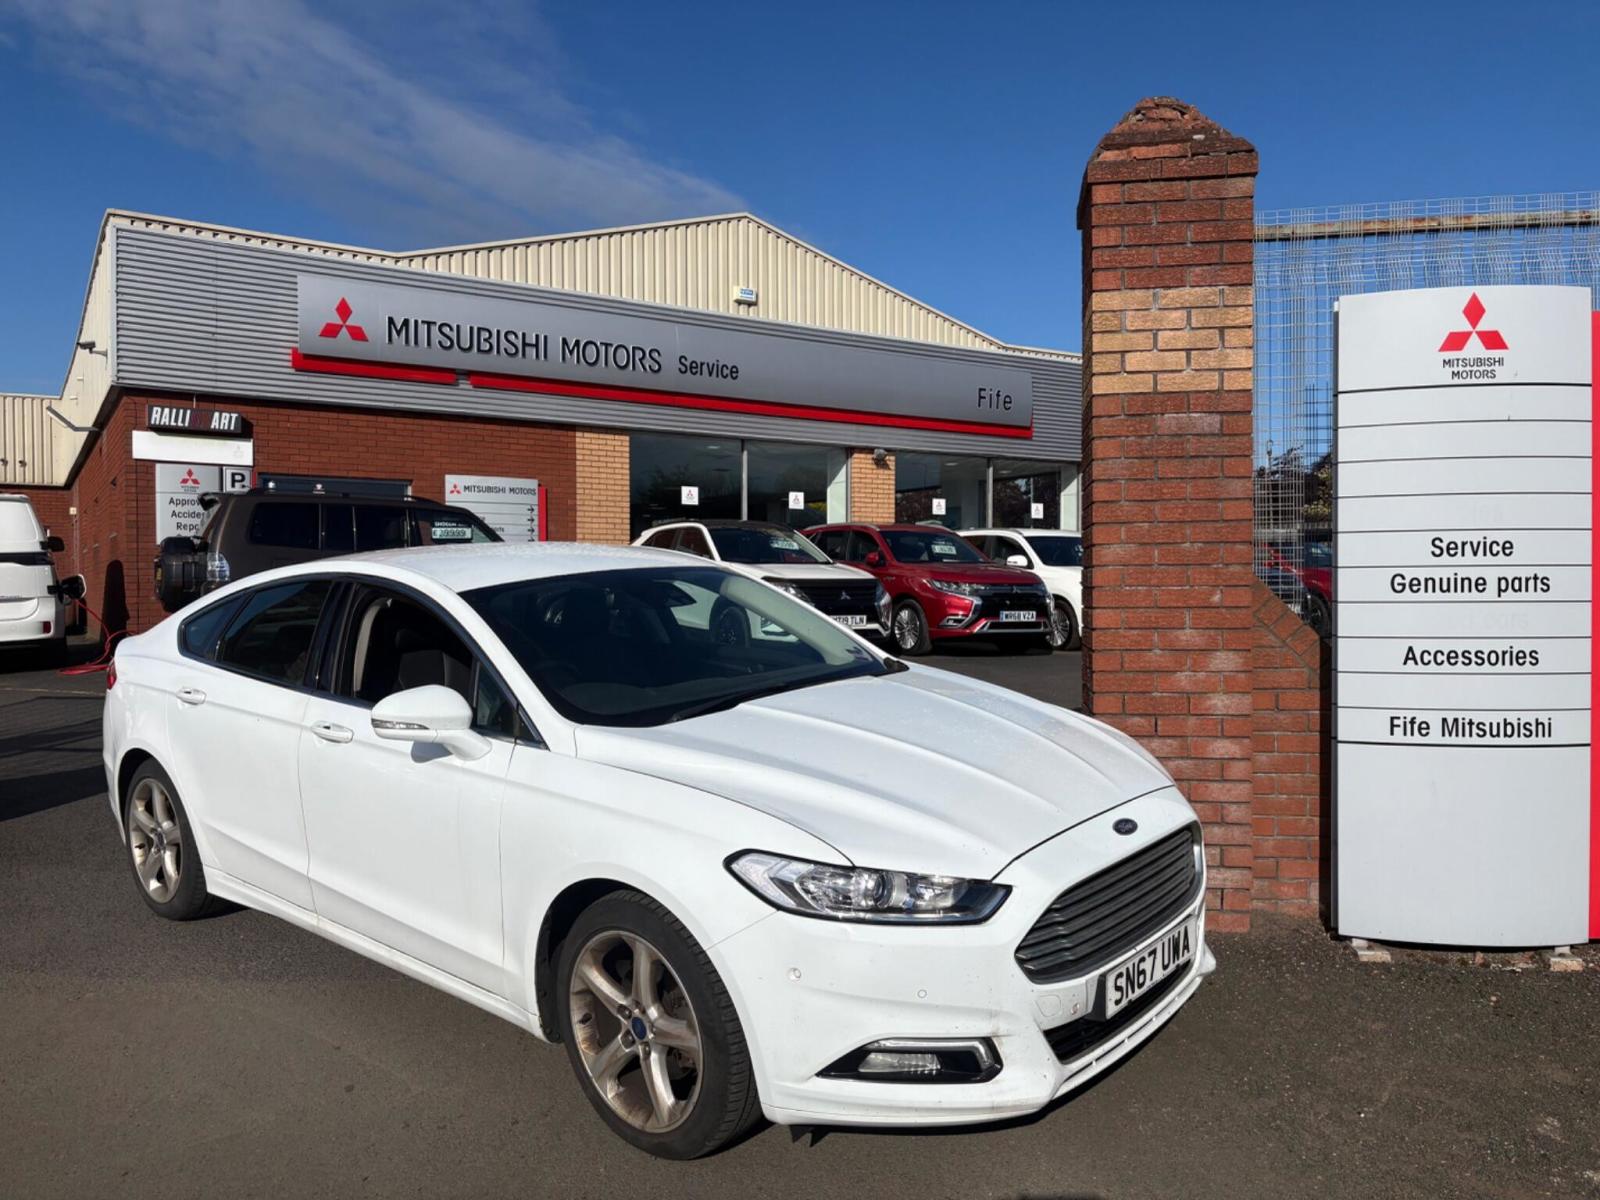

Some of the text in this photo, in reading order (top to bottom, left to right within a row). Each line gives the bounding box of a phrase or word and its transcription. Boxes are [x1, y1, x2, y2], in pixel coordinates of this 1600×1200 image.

[386, 315, 740, 381] MITSUBISHI MOTORS Service
[1442, 357, 1505, 369] MITSUBISHI
[1451, 369, 1497, 380] MOTORS
[977, 387, 1013, 411] Fife
[230, 472, 246, 489] P
[463, 485, 537, 496] MITSUBISHI MOTORS
[168, 496, 200, 507] Approv
[1430, 536, 1515, 558] Service
[1390, 573, 1551, 598] Genuine parts
[1402, 645, 1540, 667] Accessories
[1389, 716, 1552, 739] Fife Mitsubishi
[1114, 925, 1190, 1006] SN67 UWA
